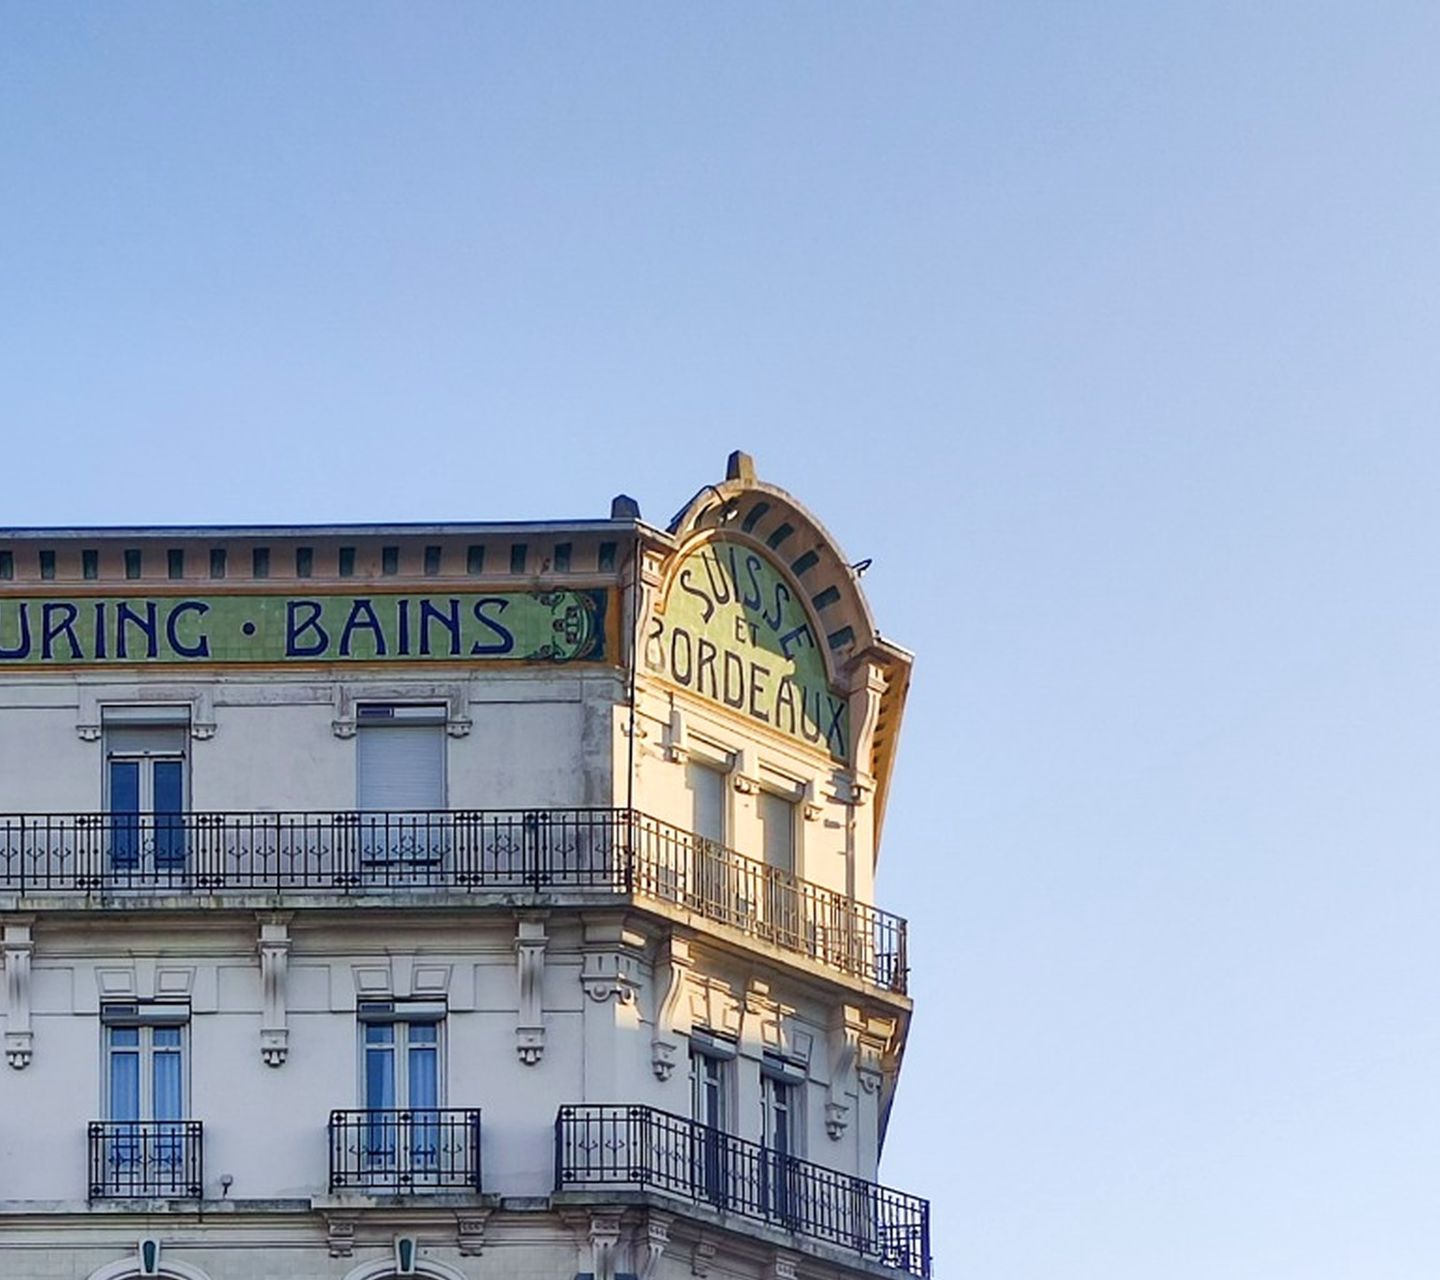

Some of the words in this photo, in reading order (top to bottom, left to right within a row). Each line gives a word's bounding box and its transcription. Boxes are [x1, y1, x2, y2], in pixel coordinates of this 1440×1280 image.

[285, 597, 516, 658] BAINS
[679, 542, 814, 661] SUISSE
[734, 615, 760, 648] ET
[644, 616, 846, 756] BORDEAUX
